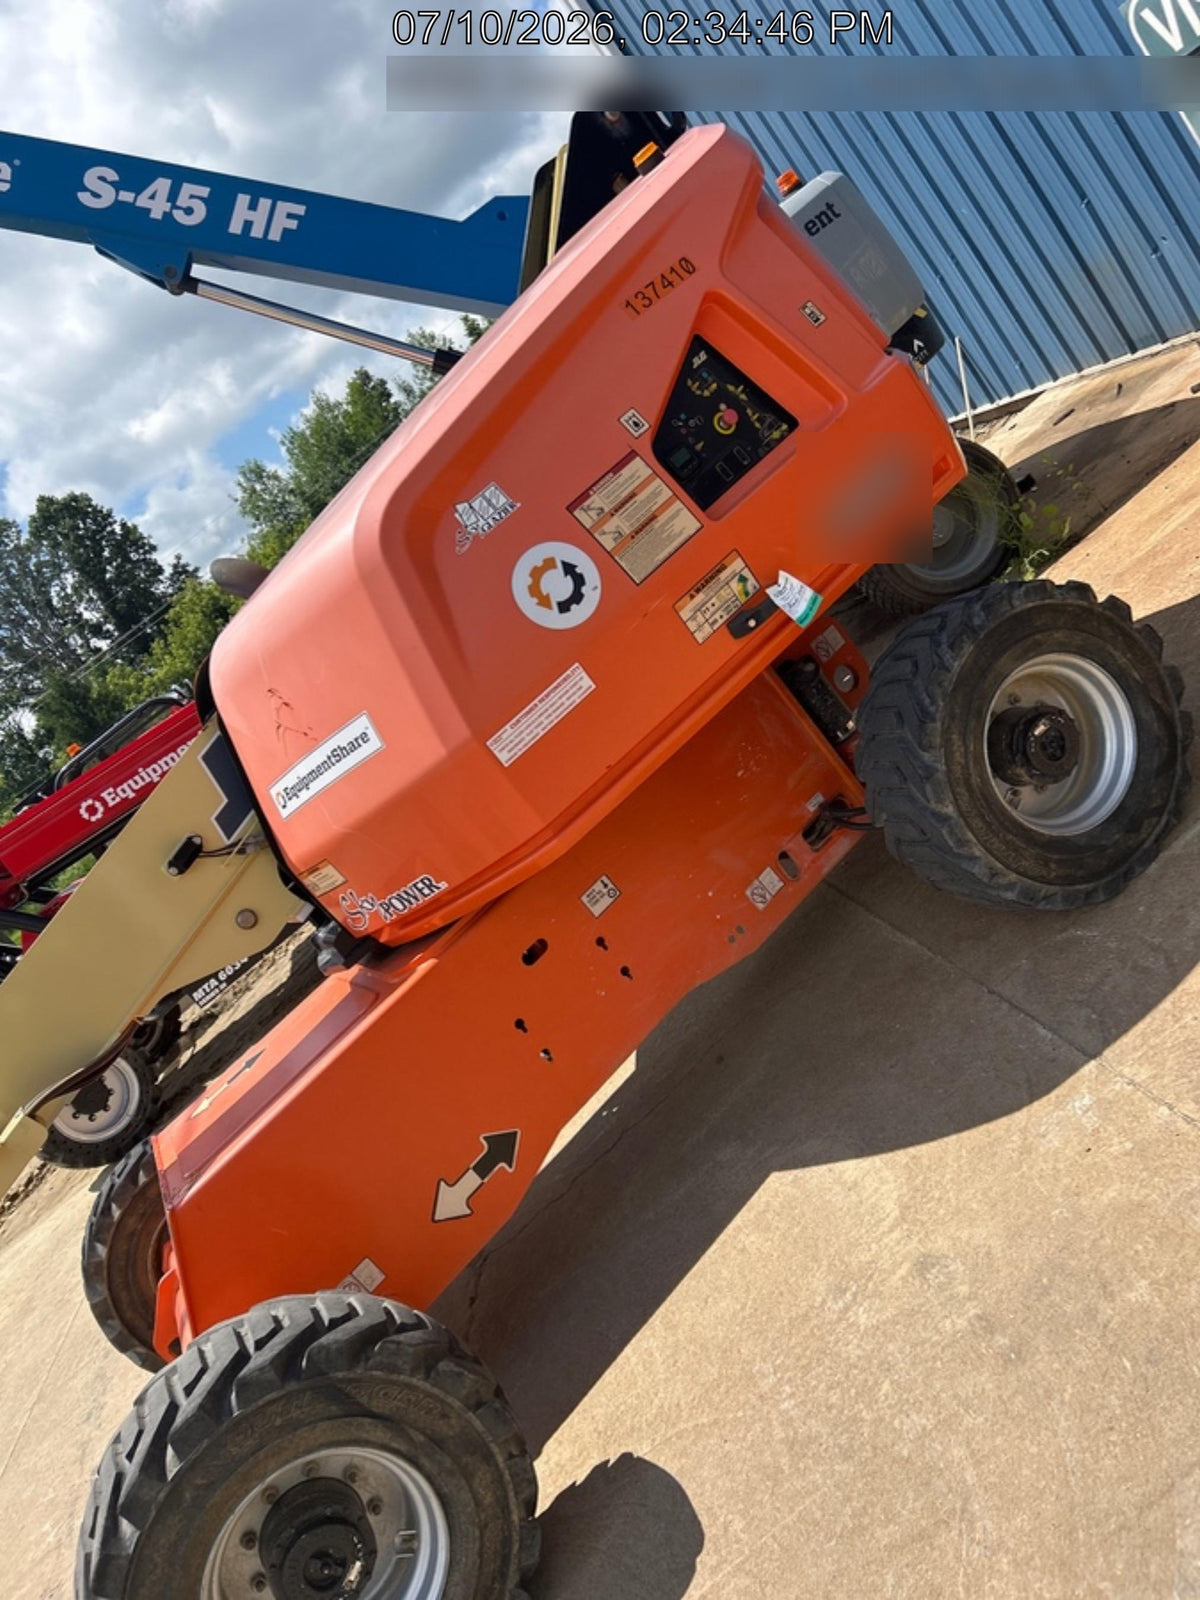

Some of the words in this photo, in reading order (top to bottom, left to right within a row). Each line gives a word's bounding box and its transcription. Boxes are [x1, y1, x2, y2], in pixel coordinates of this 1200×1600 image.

[77, 166, 211, 226] S-45
[228, 193, 307, 242] HF
[624, 256, 697, 316] 137410
[283, 731, 370, 801] EquipmentShare
[378, 875, 441, 922] POWER
[192, 977, 219, 1002] MTA
